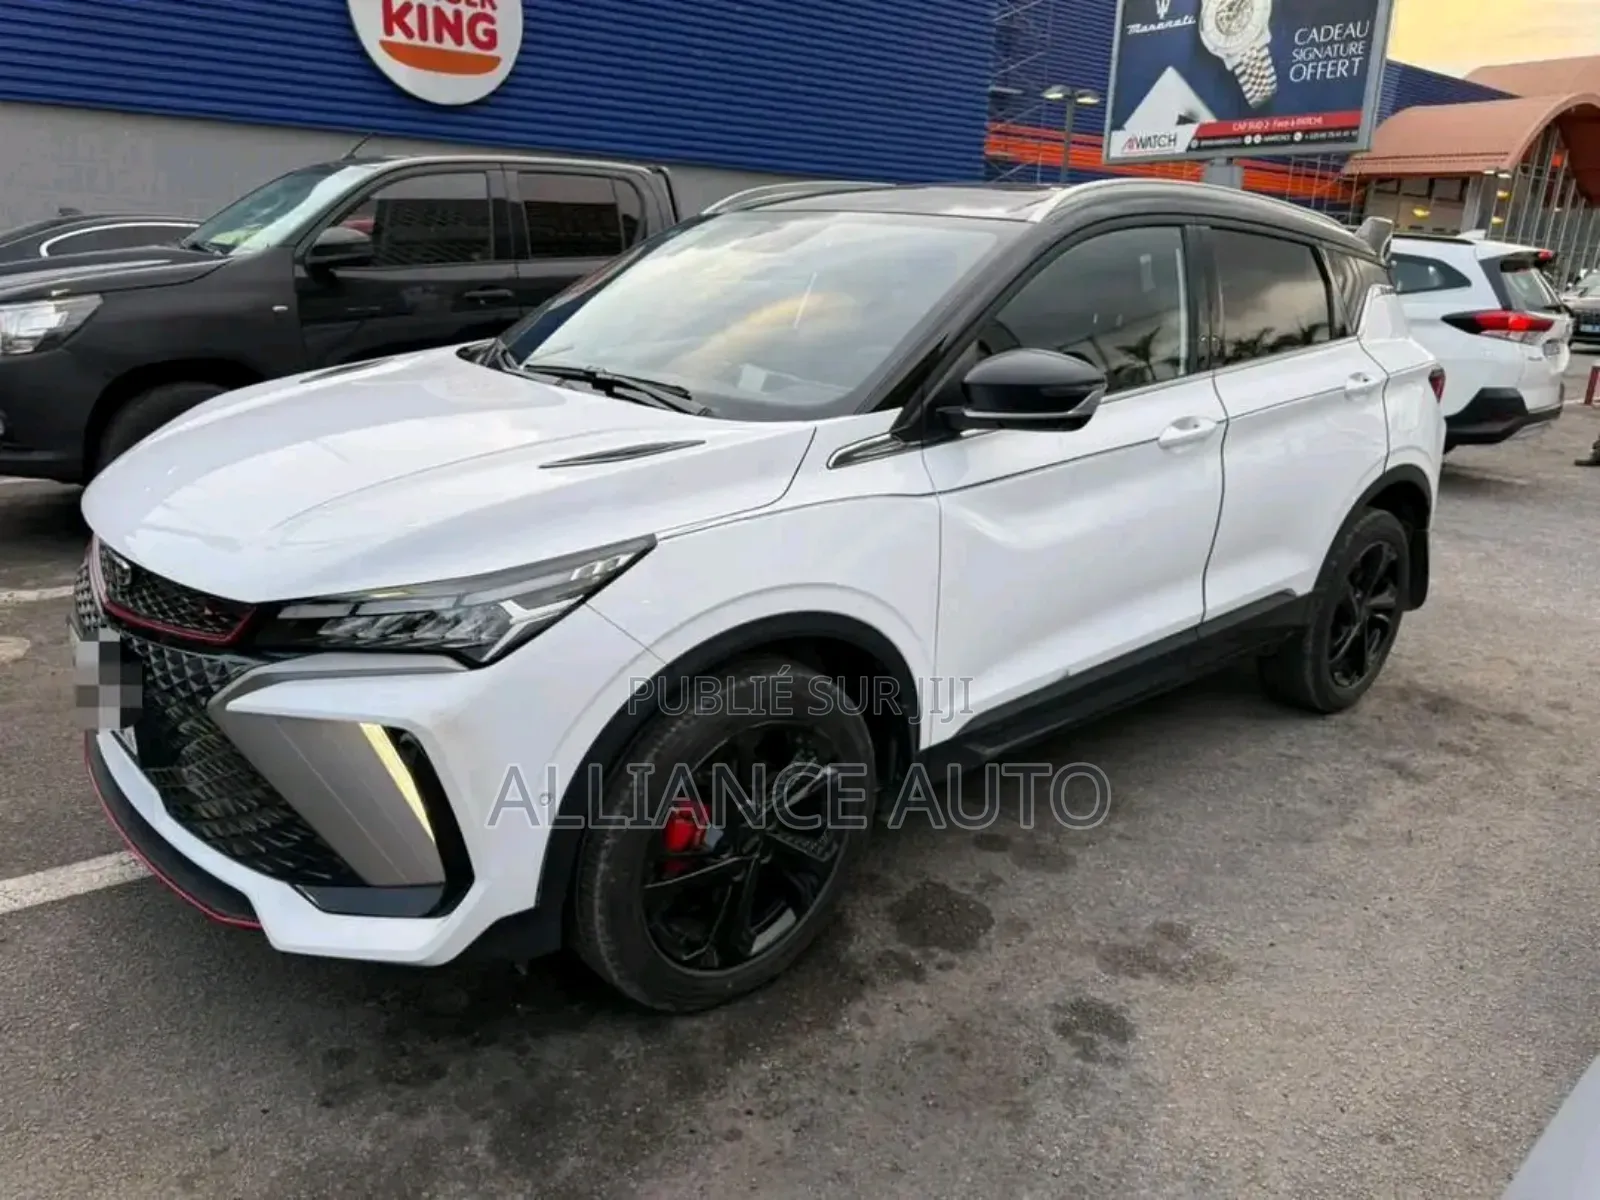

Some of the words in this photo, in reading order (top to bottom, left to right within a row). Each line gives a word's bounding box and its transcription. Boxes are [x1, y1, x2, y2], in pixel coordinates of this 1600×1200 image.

[381, 0, 498, 51] KING
[1294, 20, 1370, 46] CADEAU
[1291, 40, 1367, 63] SIGNATURE
[1289, 57, 1364, 82] OFFERT
